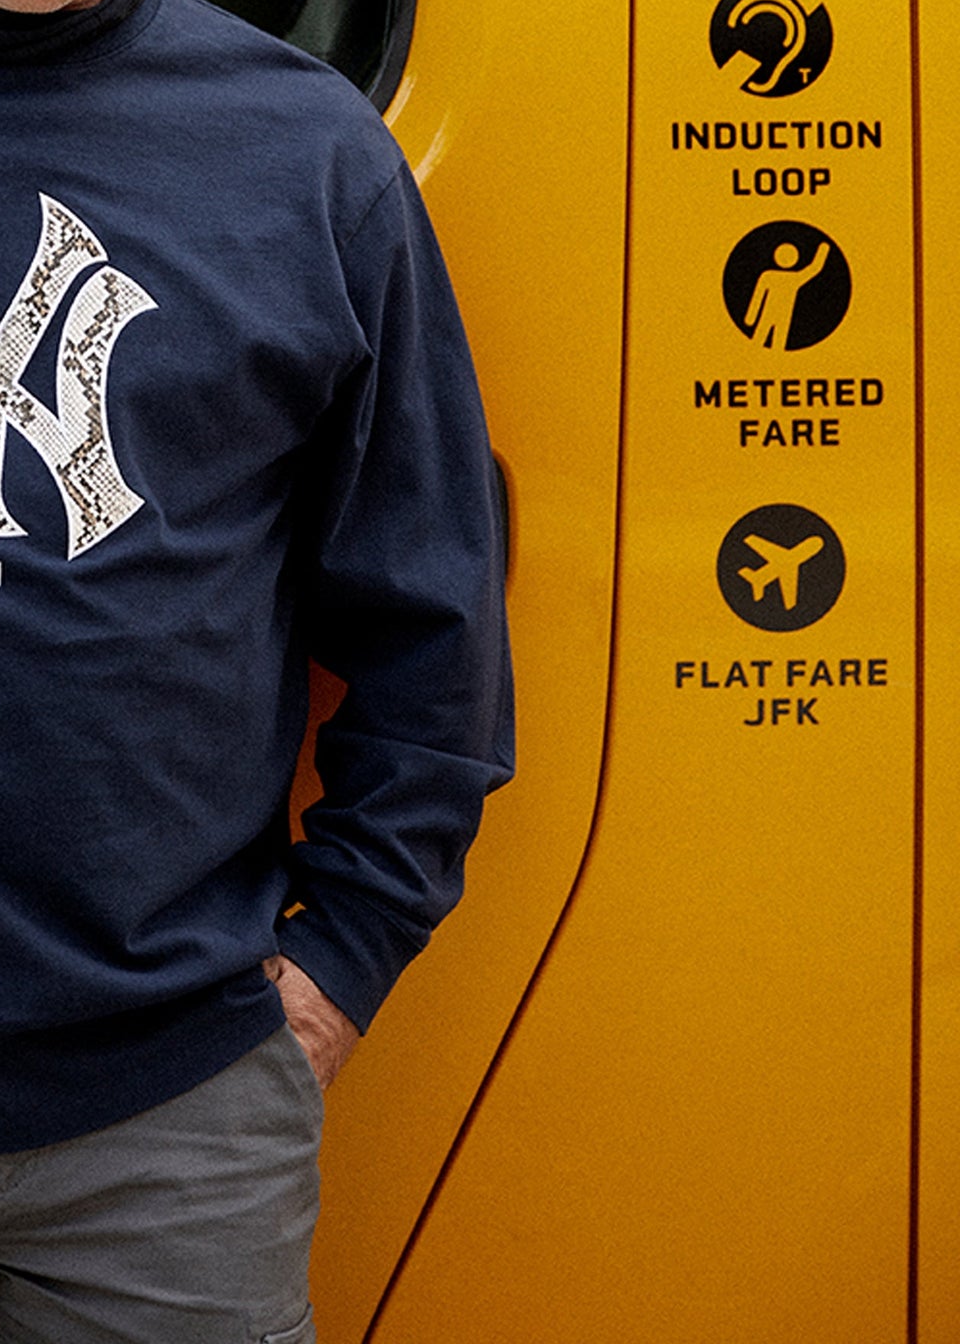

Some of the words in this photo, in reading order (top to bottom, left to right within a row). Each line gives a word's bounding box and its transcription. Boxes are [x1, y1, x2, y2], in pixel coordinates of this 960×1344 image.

[671, 120, 882, 151] INDUCTION
[732, 167, 831, 197] LOOP
[694, 378, 884, 409] METERED
[739, 418, 841, 448] FARE
[675, 660, 773, 689] FLAT
[786, 658, 889, 688] FARE
[743, 697, 820, 727] JFK
